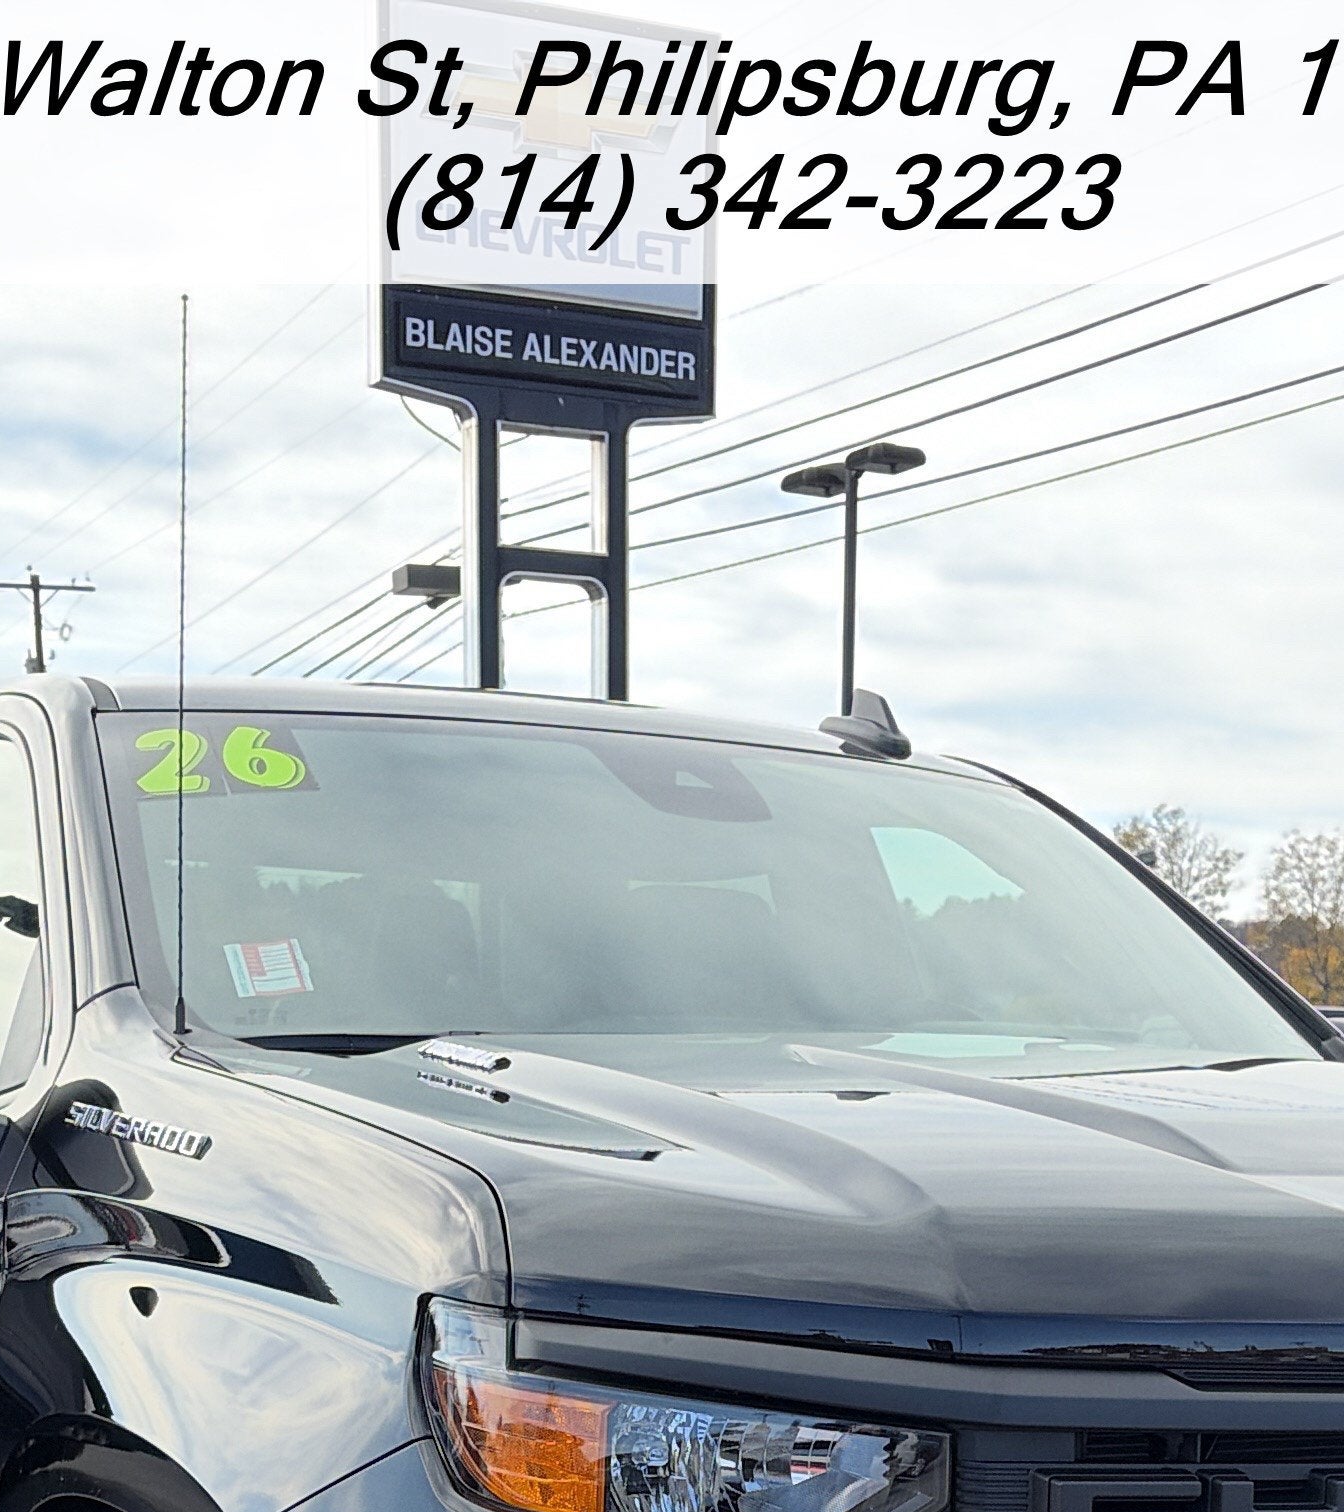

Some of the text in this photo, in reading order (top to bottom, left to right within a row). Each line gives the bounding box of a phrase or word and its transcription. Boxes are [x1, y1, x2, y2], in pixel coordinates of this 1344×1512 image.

[404, 316, 697, 382] BLAISE ALEXANDER
[135, 726, 306, 796] 26
[64, 1100, 210, 1159] SILVERADO
